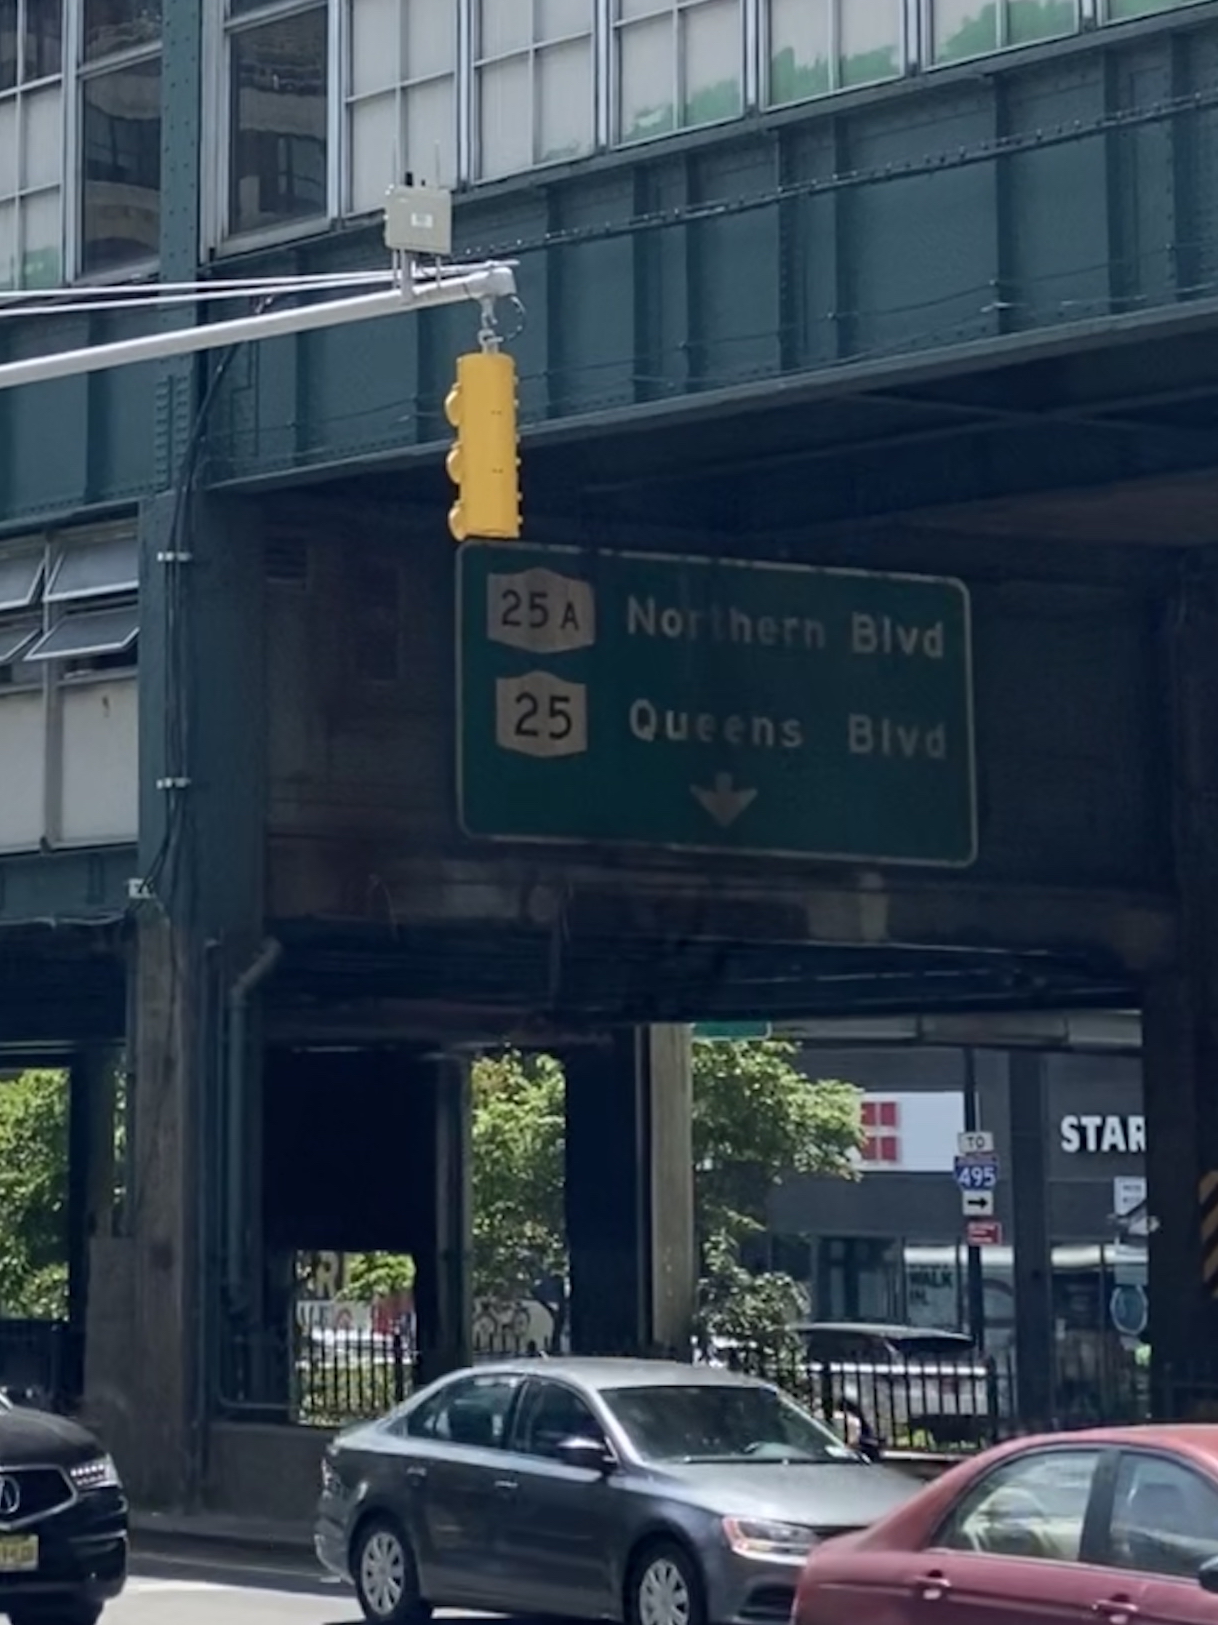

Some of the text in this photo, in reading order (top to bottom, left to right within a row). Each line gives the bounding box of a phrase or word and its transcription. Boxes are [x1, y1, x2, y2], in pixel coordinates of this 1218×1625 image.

[627, 596, 944, 659] Northern Blvd
[514, 692, 573, 740] 25
[629, 698, 946, 760] Queens Blvd
[966, 1136, 985, 1149] TO
[957, 1166, 996, 1188] 495
